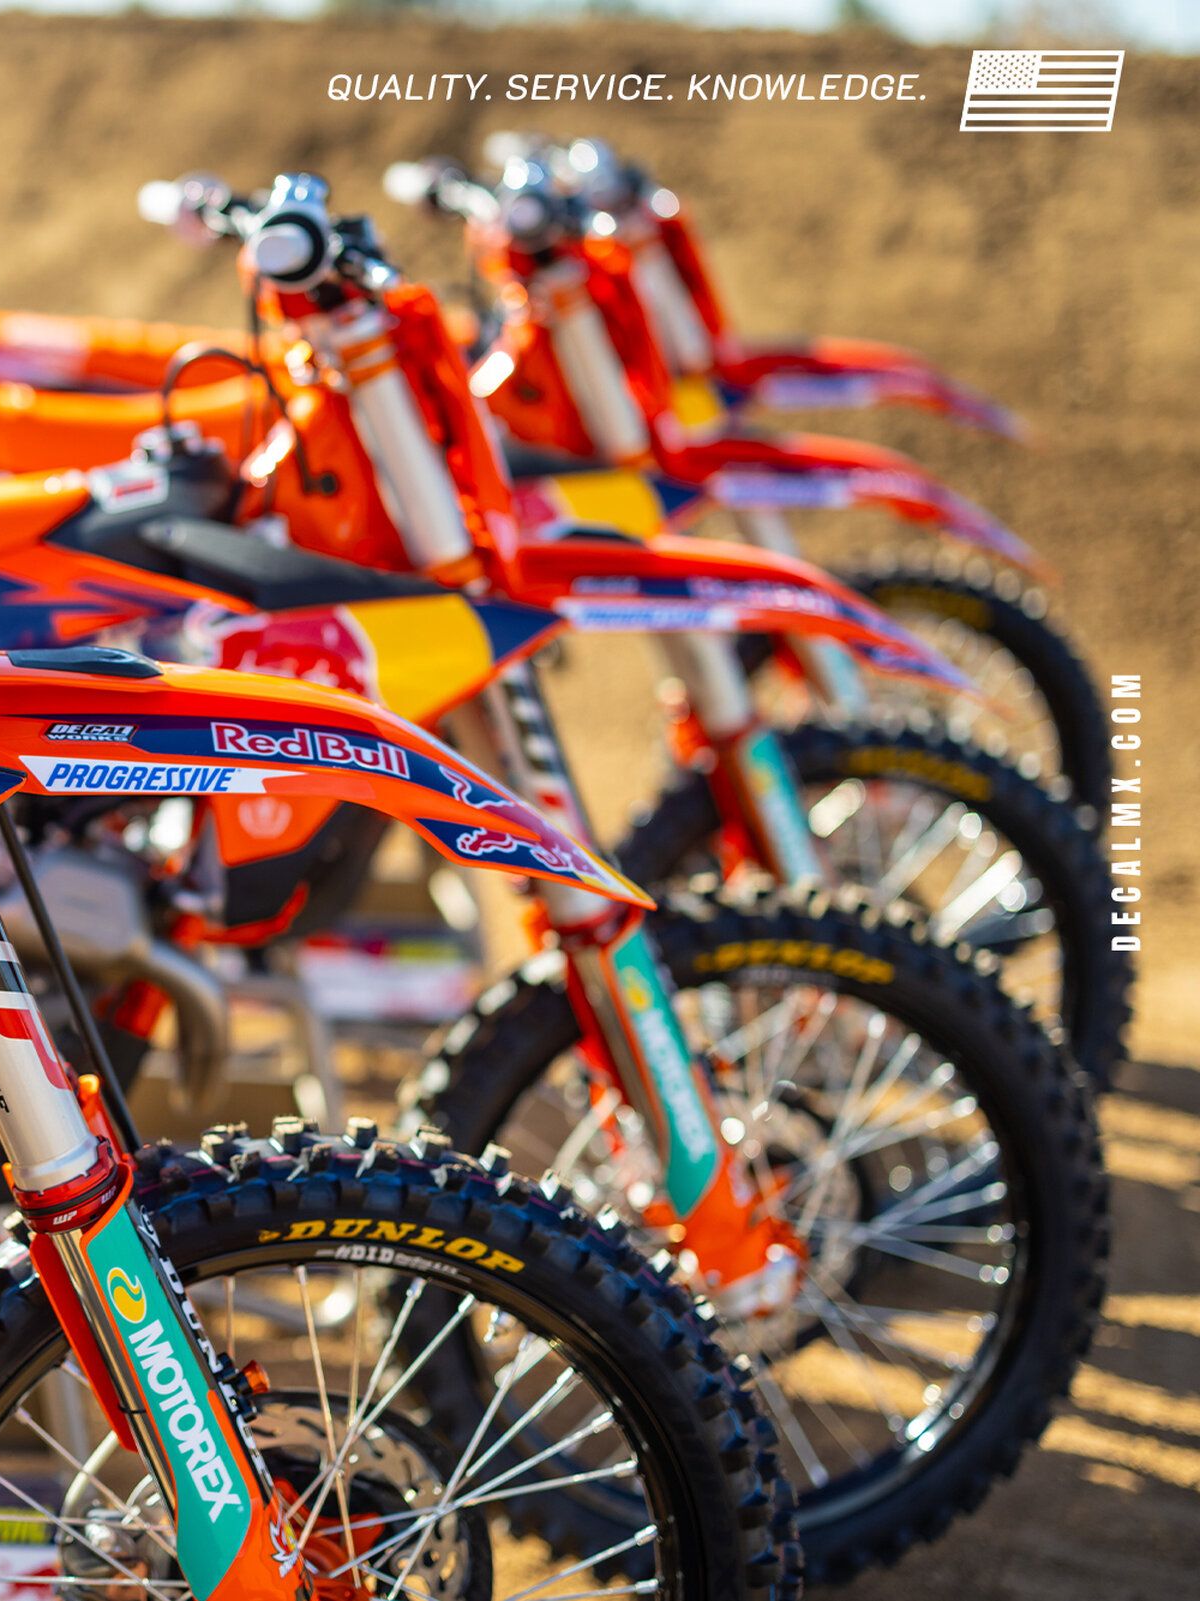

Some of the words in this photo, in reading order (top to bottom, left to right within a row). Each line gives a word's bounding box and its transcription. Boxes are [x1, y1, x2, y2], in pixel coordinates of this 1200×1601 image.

[46, 762, 235, 792] PROGRESSIVE
[210, 721, 310, 759] Red
[314, 727, 411, 780] Bull
[283, 1218, 526, 1274] DUNLOP
[128, 1319, 242, 1523] MOTOREX
